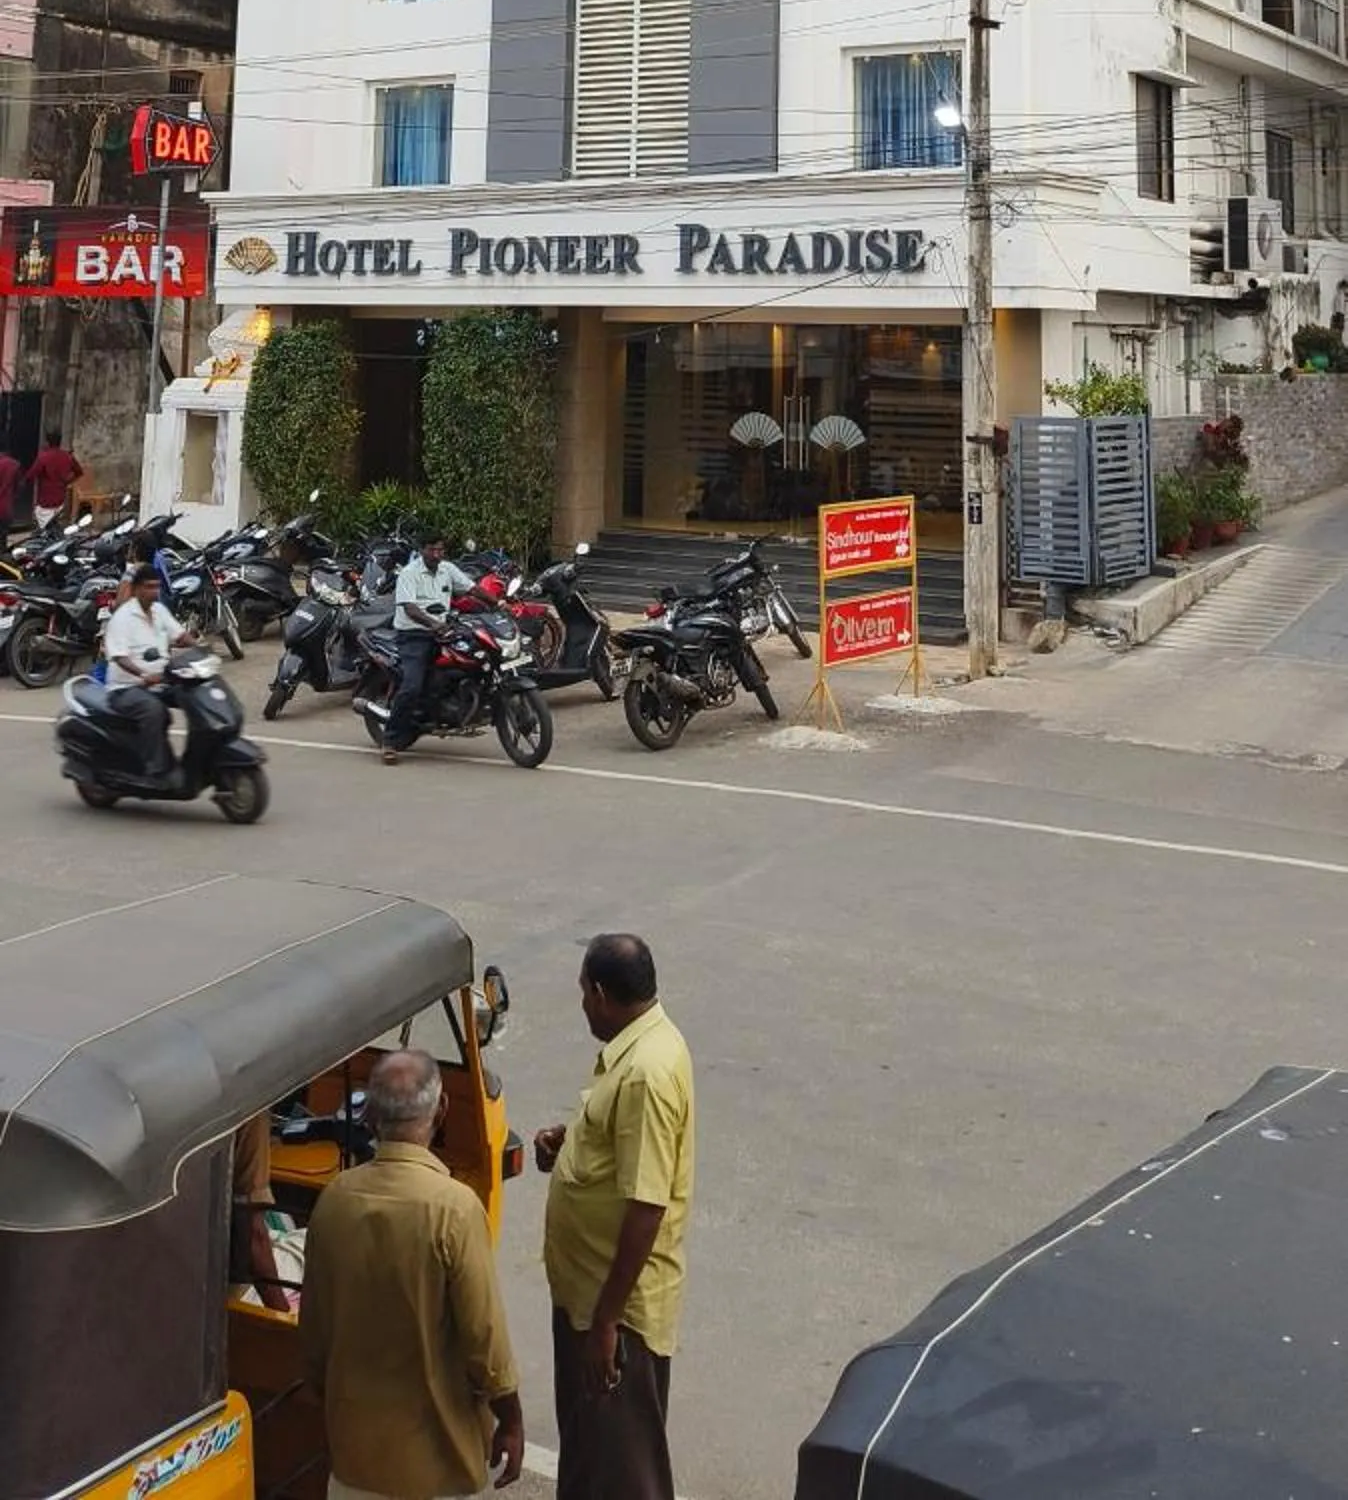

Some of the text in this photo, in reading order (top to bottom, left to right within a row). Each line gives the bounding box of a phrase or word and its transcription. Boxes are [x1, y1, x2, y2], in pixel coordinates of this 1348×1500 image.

[154, 121, 211, 164] BAR
[101, 232, 159, 244] PARADIS
[284, 223, 927, 277] HOTEL PIONEER PARADISE
[75, 245, 186, 285] BAR
